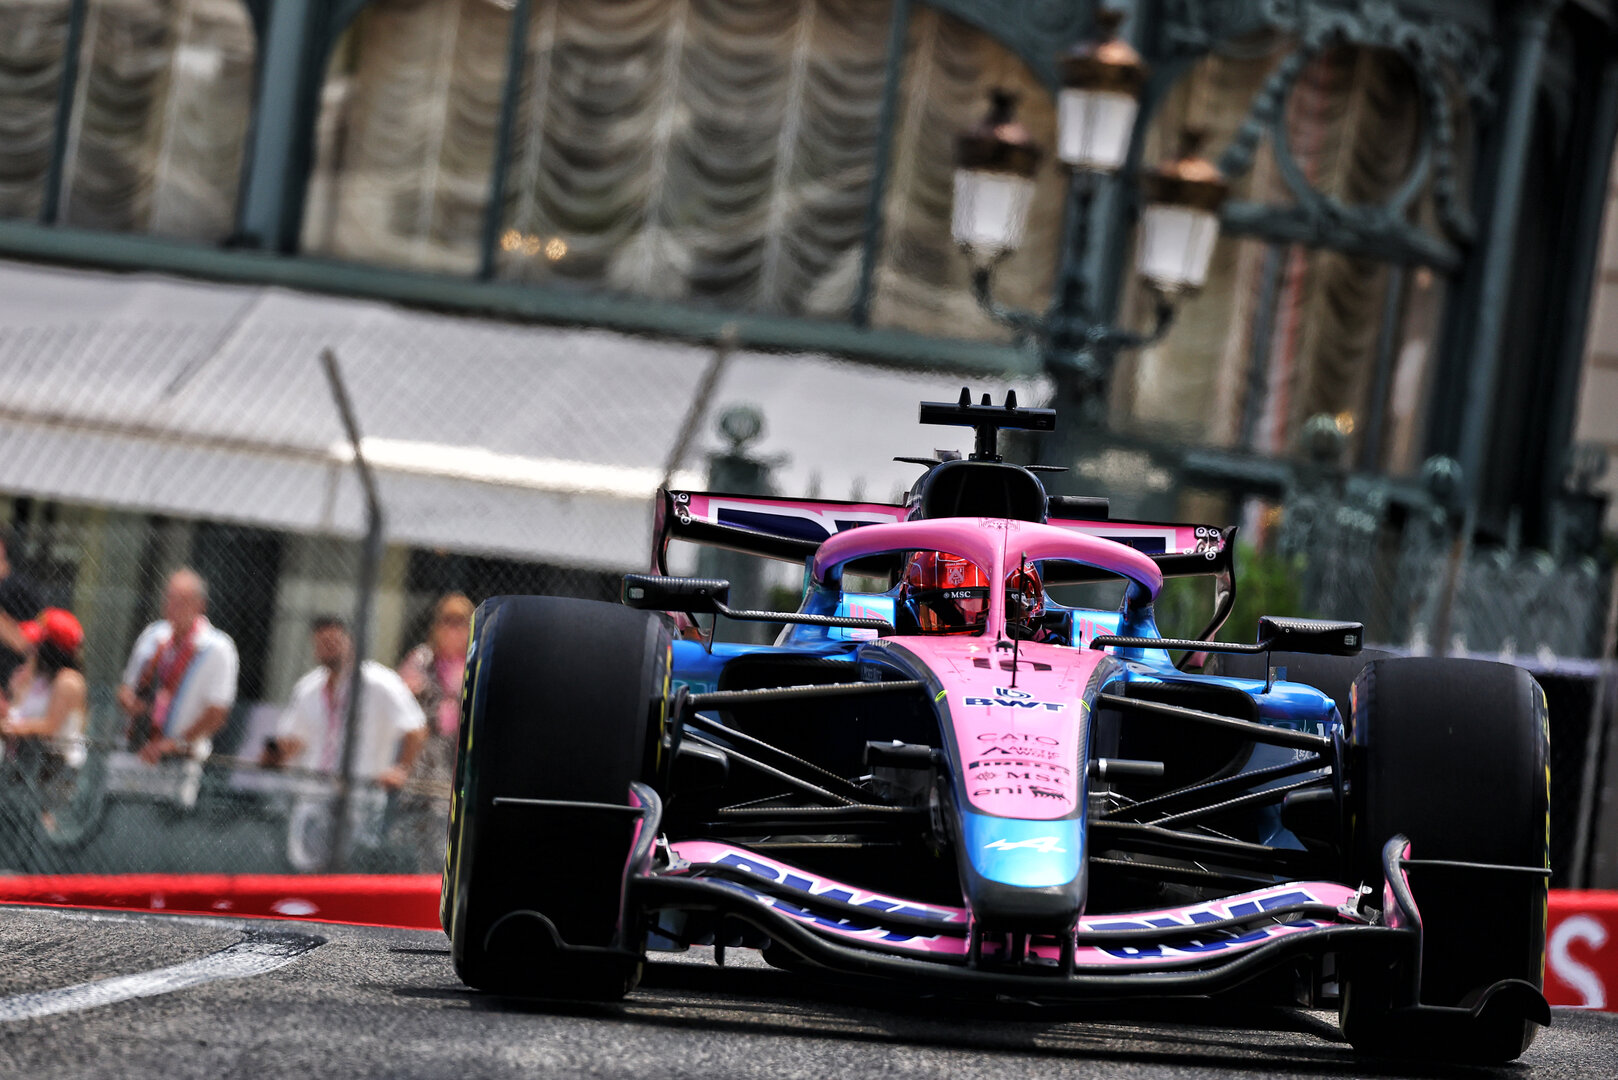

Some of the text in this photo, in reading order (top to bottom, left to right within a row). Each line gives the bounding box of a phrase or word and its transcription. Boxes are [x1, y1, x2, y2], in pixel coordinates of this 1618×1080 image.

[951, 590, 971, 599] MSC
[965, 698, 1064, 711] BWT
[973, 785, 1022, 797] eni
